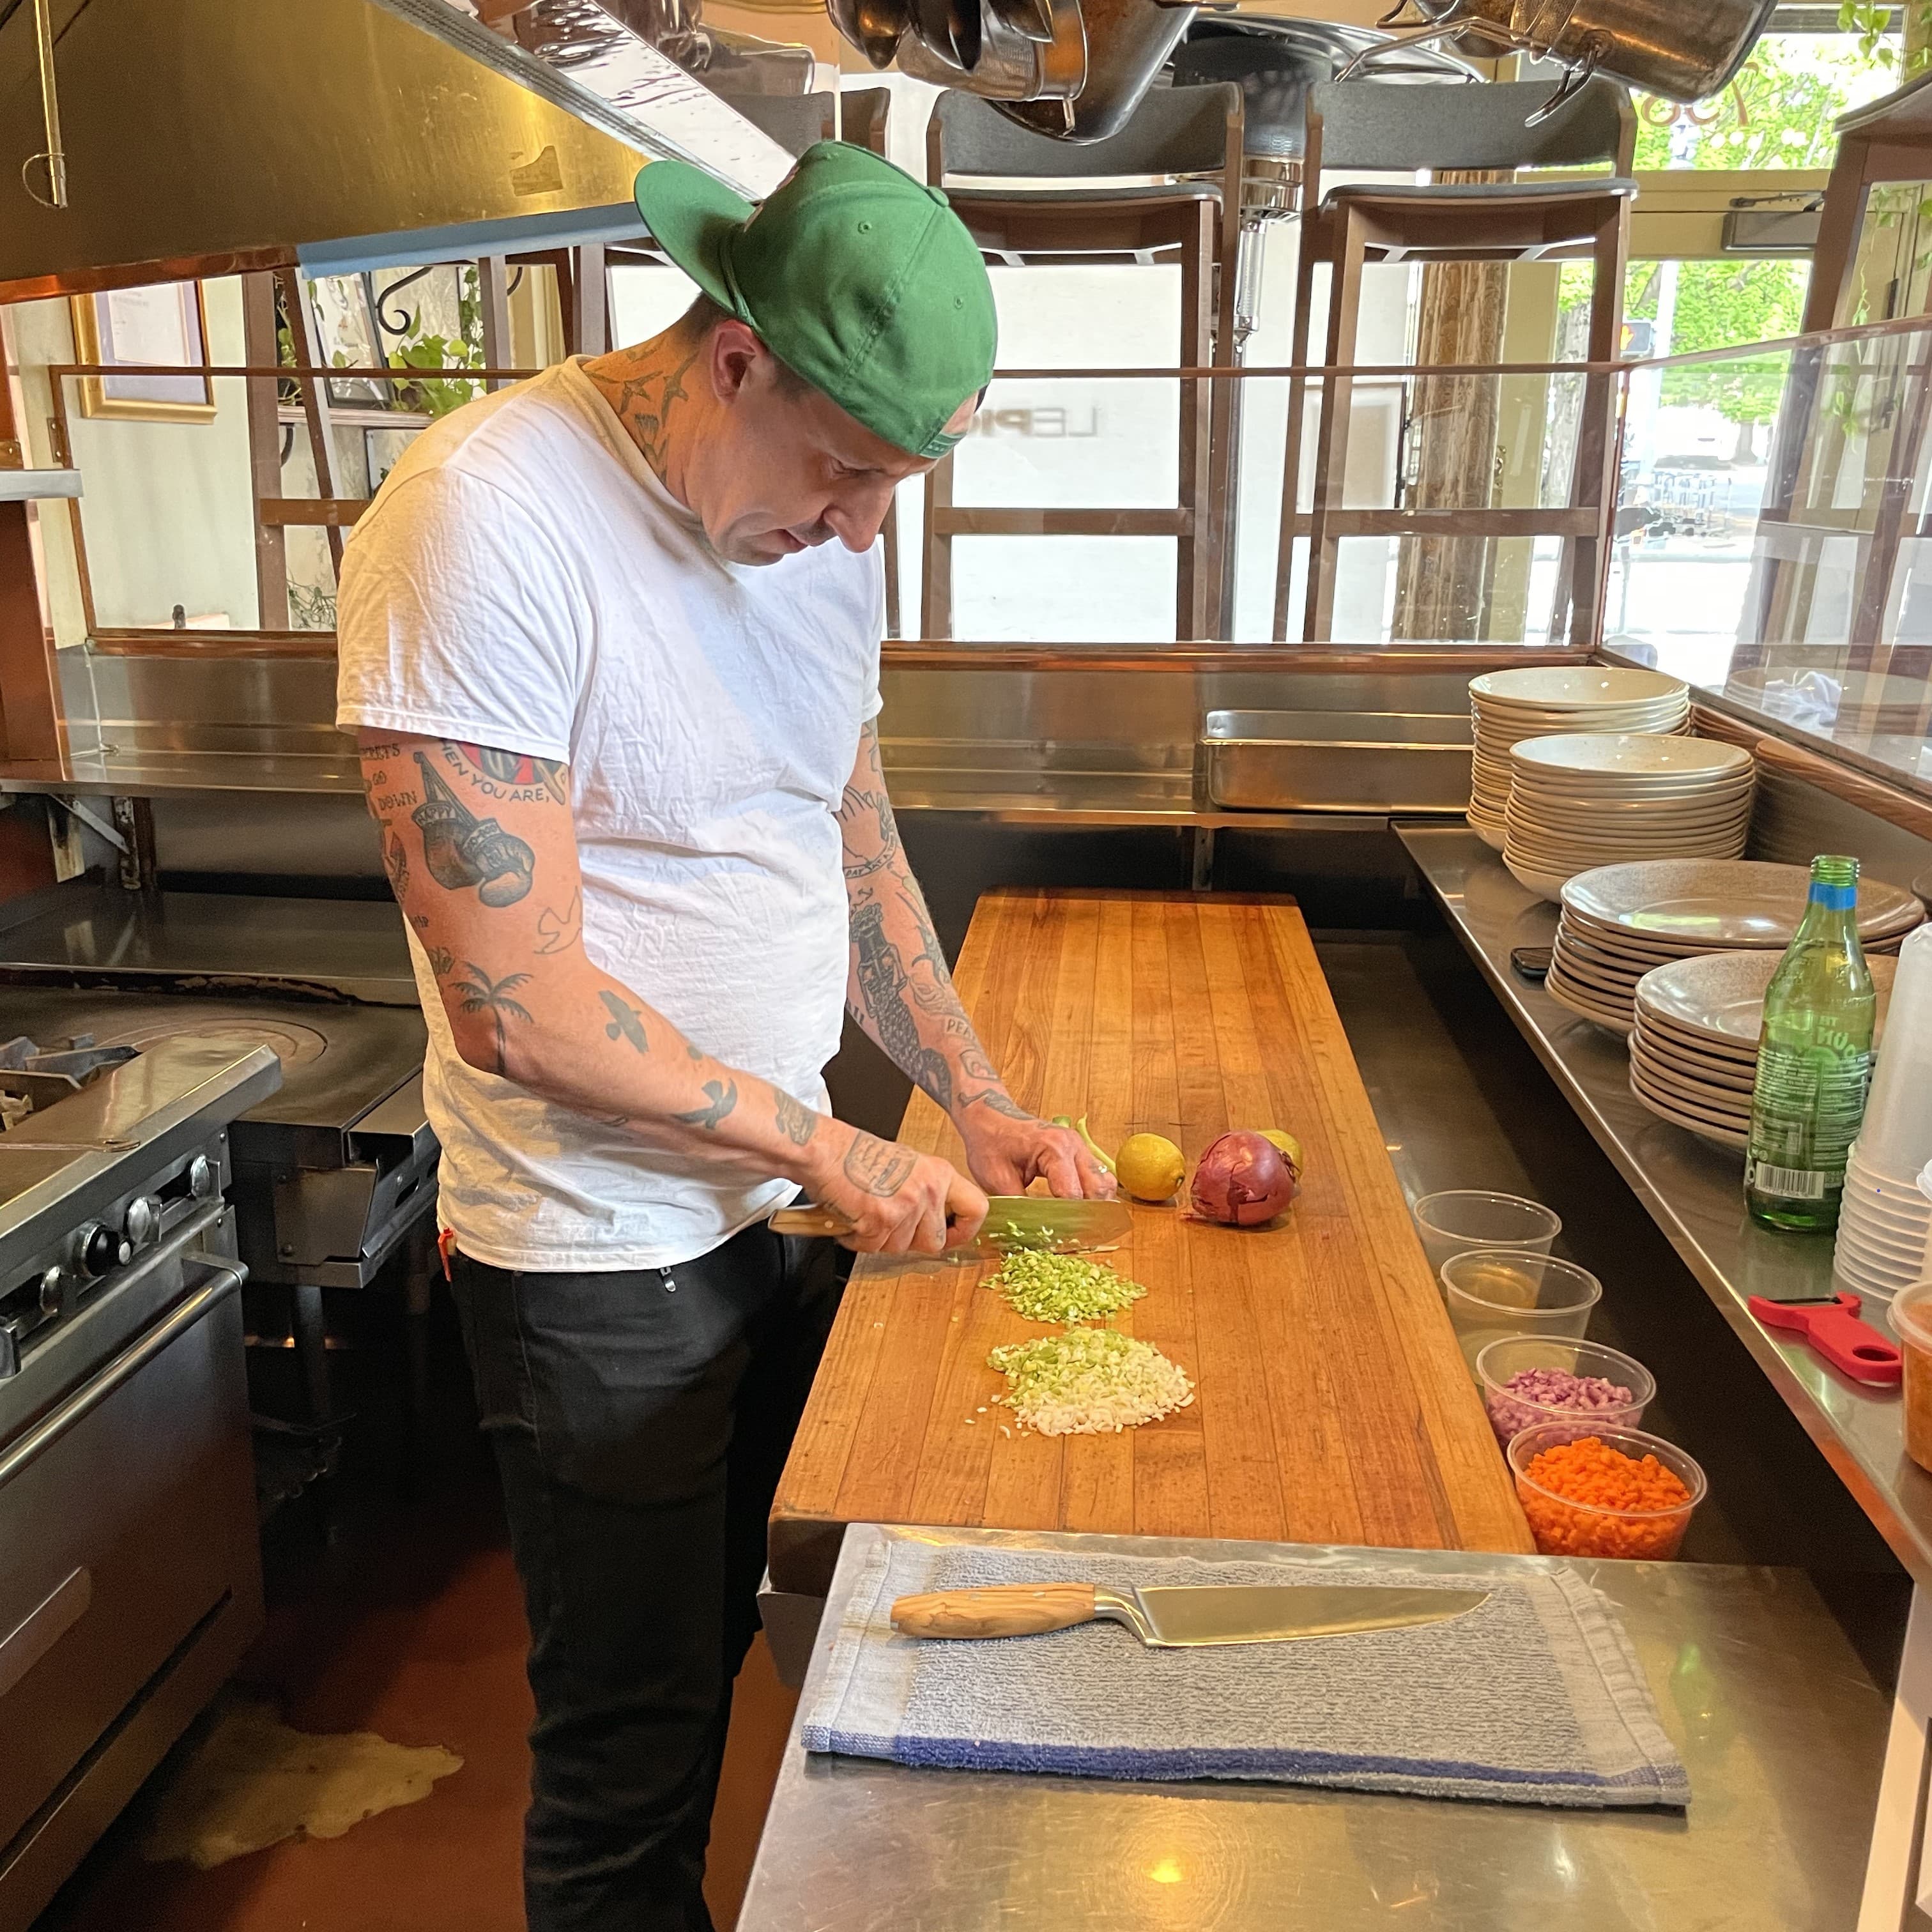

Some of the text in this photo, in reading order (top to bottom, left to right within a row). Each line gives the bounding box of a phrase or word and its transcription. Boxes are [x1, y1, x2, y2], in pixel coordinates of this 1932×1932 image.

[440, 739, 549, 803] HEN YOU ARE,
[378, 790, 417, 811] DOWN
[845, 868, 864, 877] DAY
